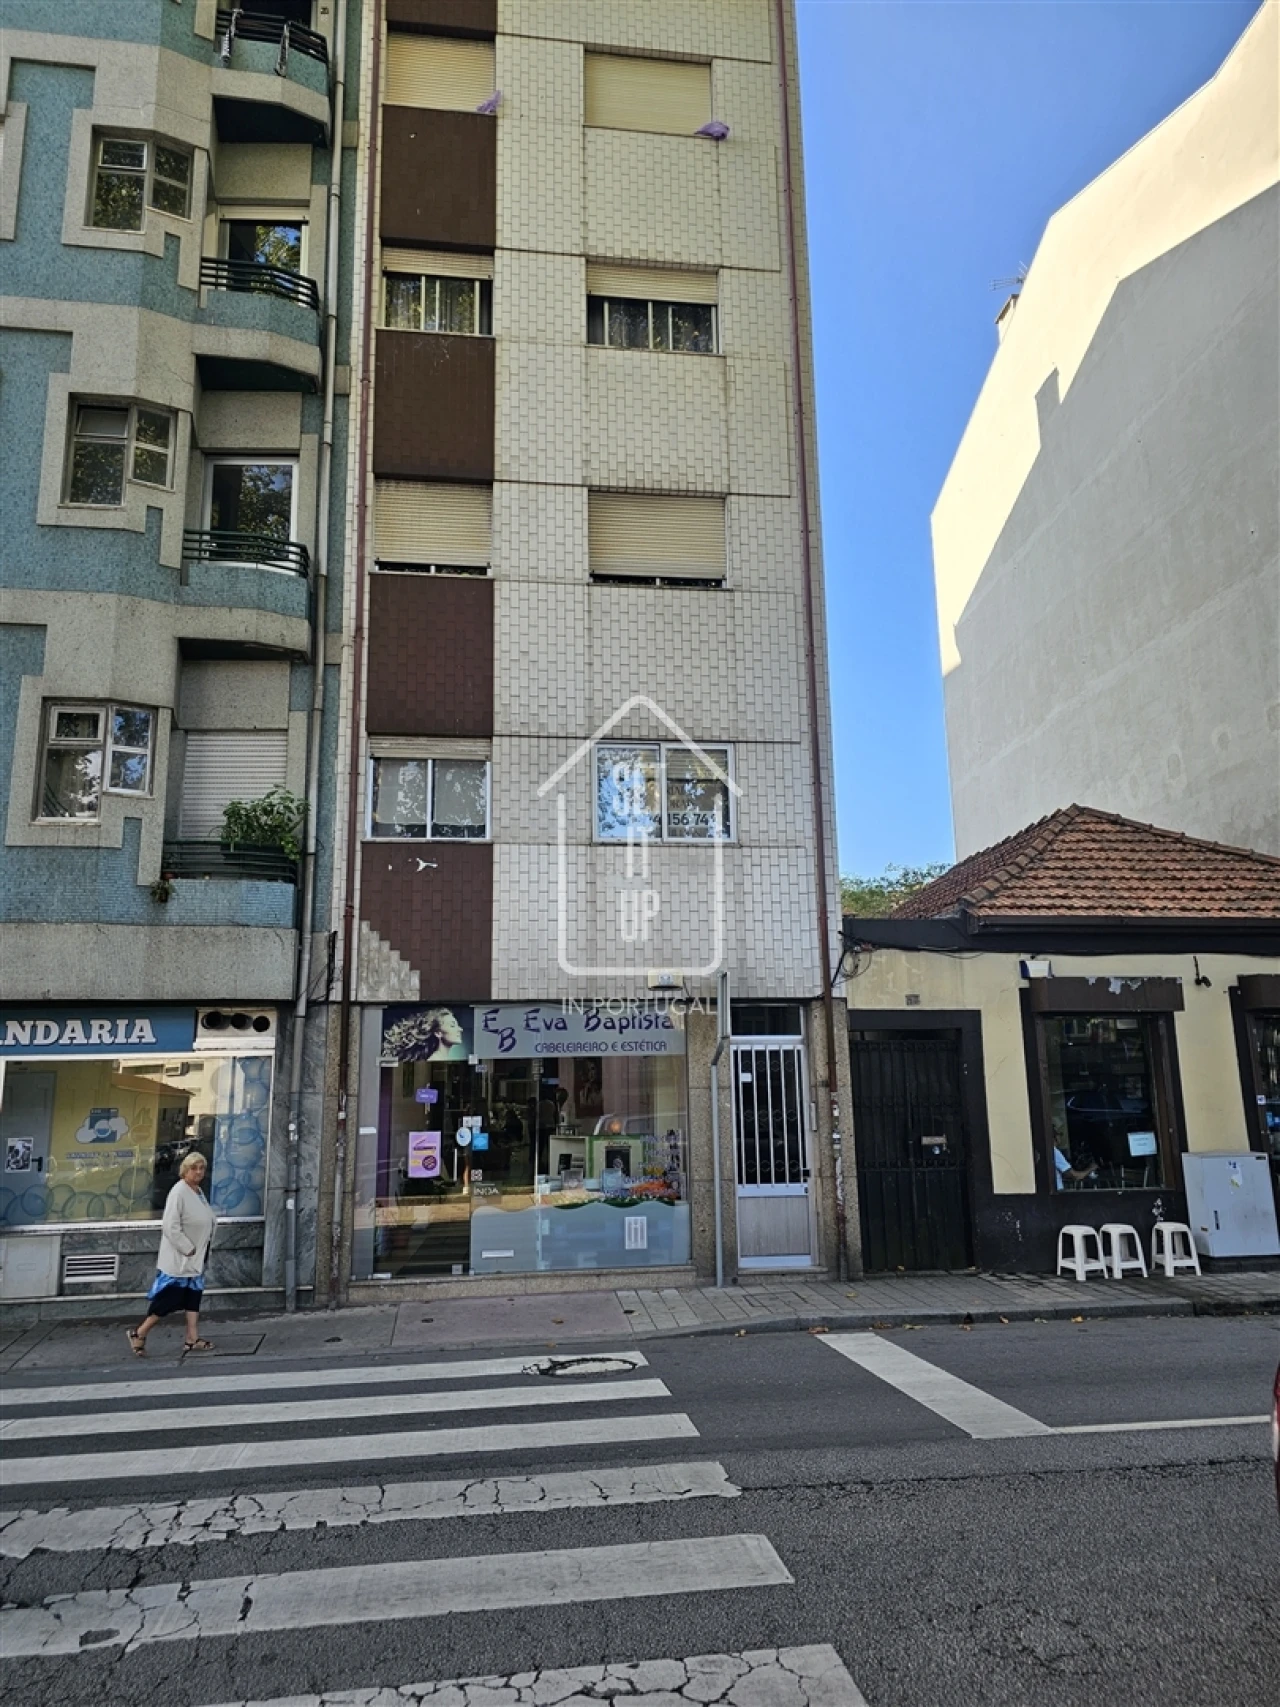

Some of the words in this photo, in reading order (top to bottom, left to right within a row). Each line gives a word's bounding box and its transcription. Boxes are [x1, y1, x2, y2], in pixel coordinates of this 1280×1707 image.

[0, 1019, 156, 1046] NDARIA
[524, 1008, 568, 1032] Eva
[583, 1009, 675, 1034] Baptista
[621, 1039, 667, 1051] ESTÉTICA
